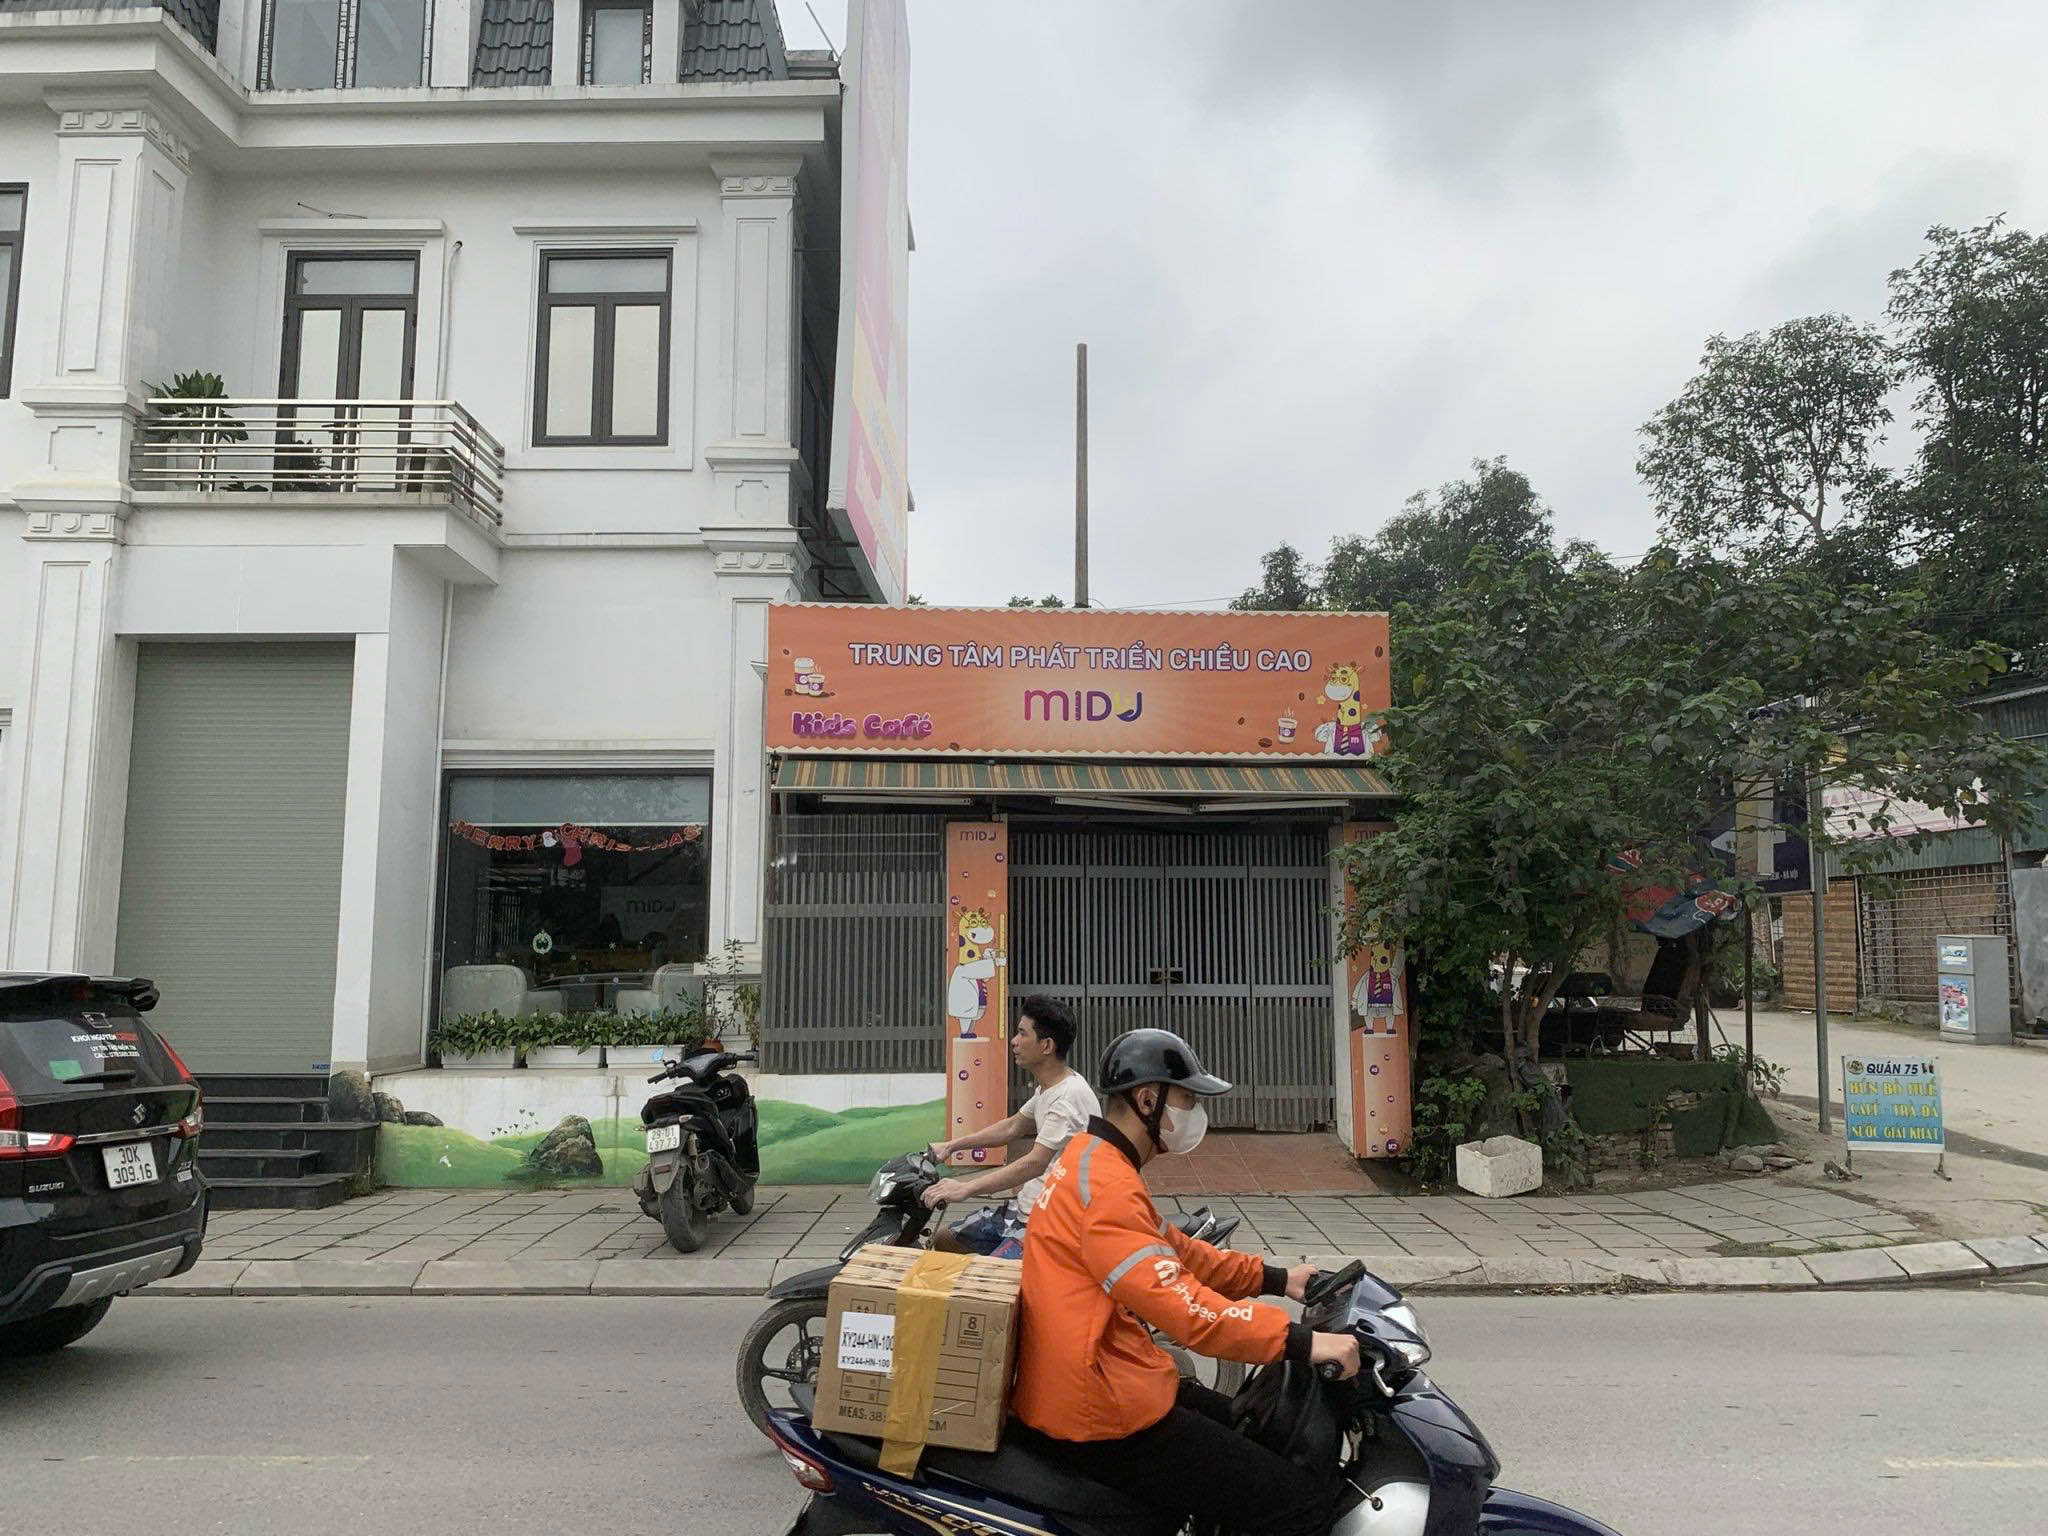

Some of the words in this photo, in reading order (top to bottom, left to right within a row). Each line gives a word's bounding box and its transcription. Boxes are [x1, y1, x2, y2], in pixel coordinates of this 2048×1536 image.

[849, 643, 943, 666] TRUNG
[947, 641, 1003, 667] TÂM
[1009, 643, 1081, 668] PHÁT
[1084, 640, 1162, 670] TRIỂN
[1168, 642, 1250, 671] CHIỀU
[1256, 649, 1311, 672] CAO
[792, 712, 857, 737] Kids
[863, 712, 934, 739] Café
[1866, 1061, 1901, 1074] QUÁN
[1904, 1064, 1918, 1074] 75
[119, 1146, 141, 1164] 30K
[113, 1163, 153, 1184] 309.16
[28, 1182, 65, 1193] SUZUKI
[968, 1316, 977, 1329] 8
[839, 1406, 868, 1420] MEAS:
